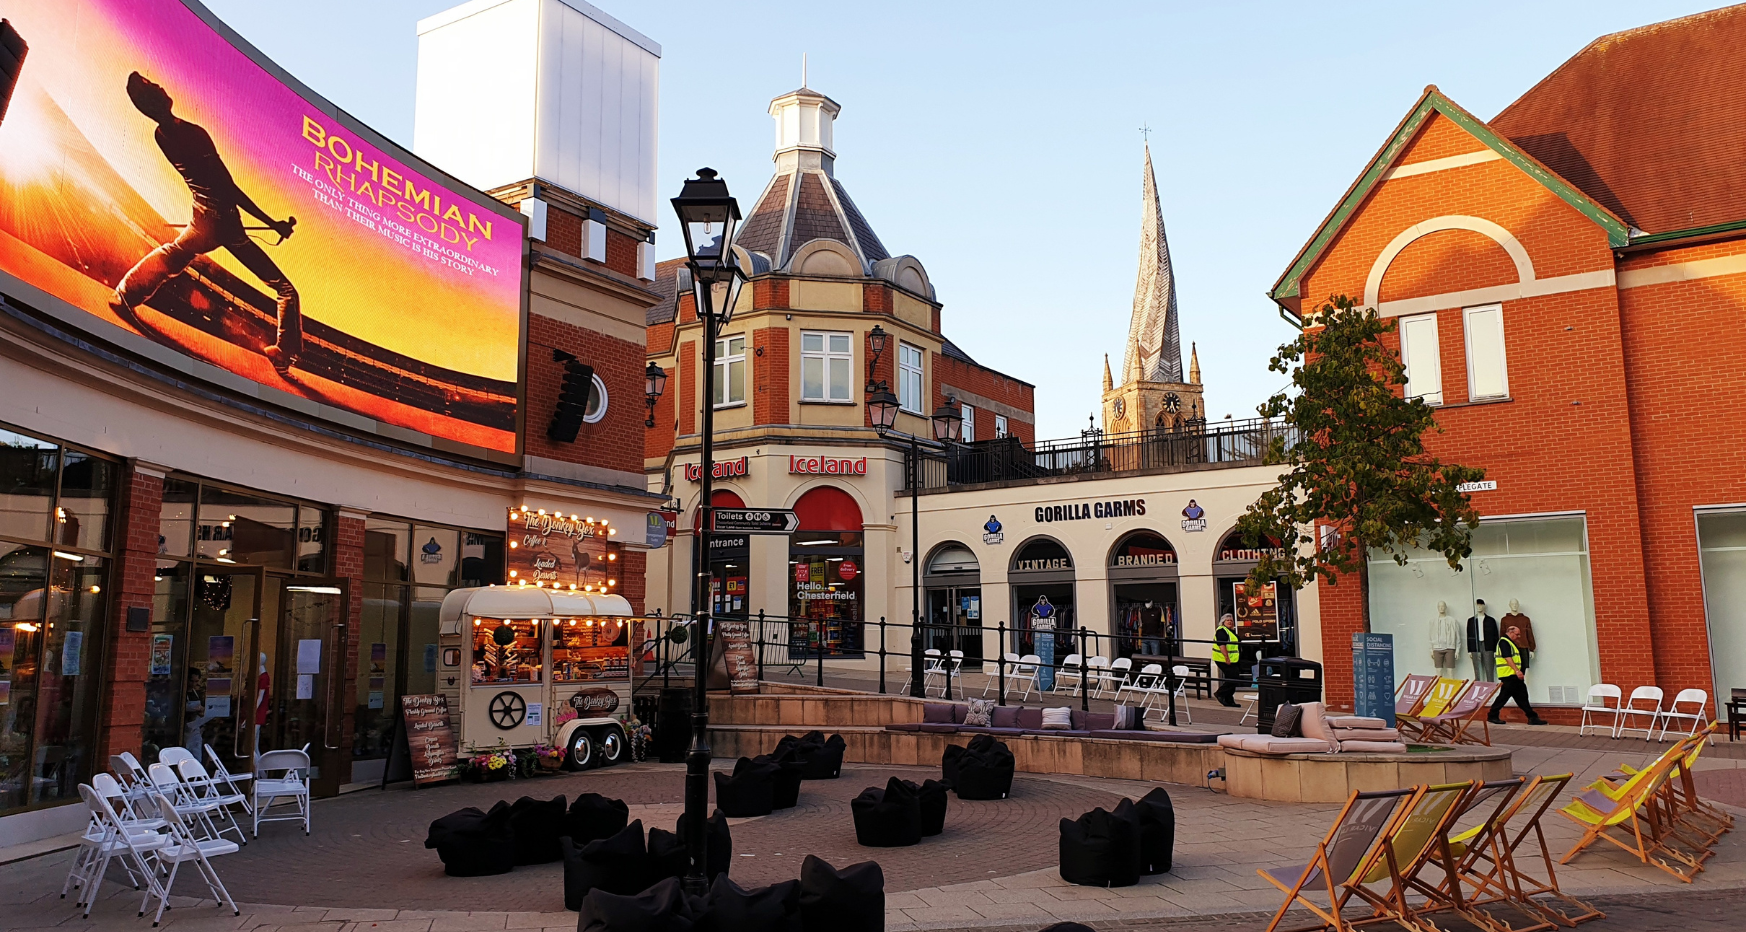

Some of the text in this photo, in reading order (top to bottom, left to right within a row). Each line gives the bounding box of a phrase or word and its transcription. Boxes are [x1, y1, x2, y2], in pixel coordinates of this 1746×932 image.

[301, 114, 493, 241] BOHEMIAN
[314, 150, 478, 251] RHAPSODY
[291, 163, 499, 276] THE ONLY THING MORE EXTRAORDINARY
[312, 188, 475, 276] THAN THEIR MUSIC IS HIS STORY
[684, 455, 746, 481] Iceand
[788, 454, 868, 475] Iceland
[716, 512, 743, 520] Toilets
[1034, 498, 1146, 523] GORILLA GARMS
[524, 513, 595, 540] The Donkey Box
[1182, 519, 1205, 527] GORILLA
[523, 534, 541, 547] Coffee
[709, 538, 744, 548] ntrance
[983, 533, 1003, 541] GORILLA
[534, 558, 556, 570] Loaded
[1018, 558, 1068, 570] VINTAGE
[1118, 553, 1173, 566] BRANDED
[533, 569, 557, 582] Desserts
[810, 566, 823, 574] FREE
[796, 581, 830, 590] Hello...
[797, 591, 856, 600] Chesterfield
[1032, 618, 1055, 626] GORILLA
[403, 695, 445, 707] The Donkey Box
[573, 694, 618, 710] The Donkey Box
